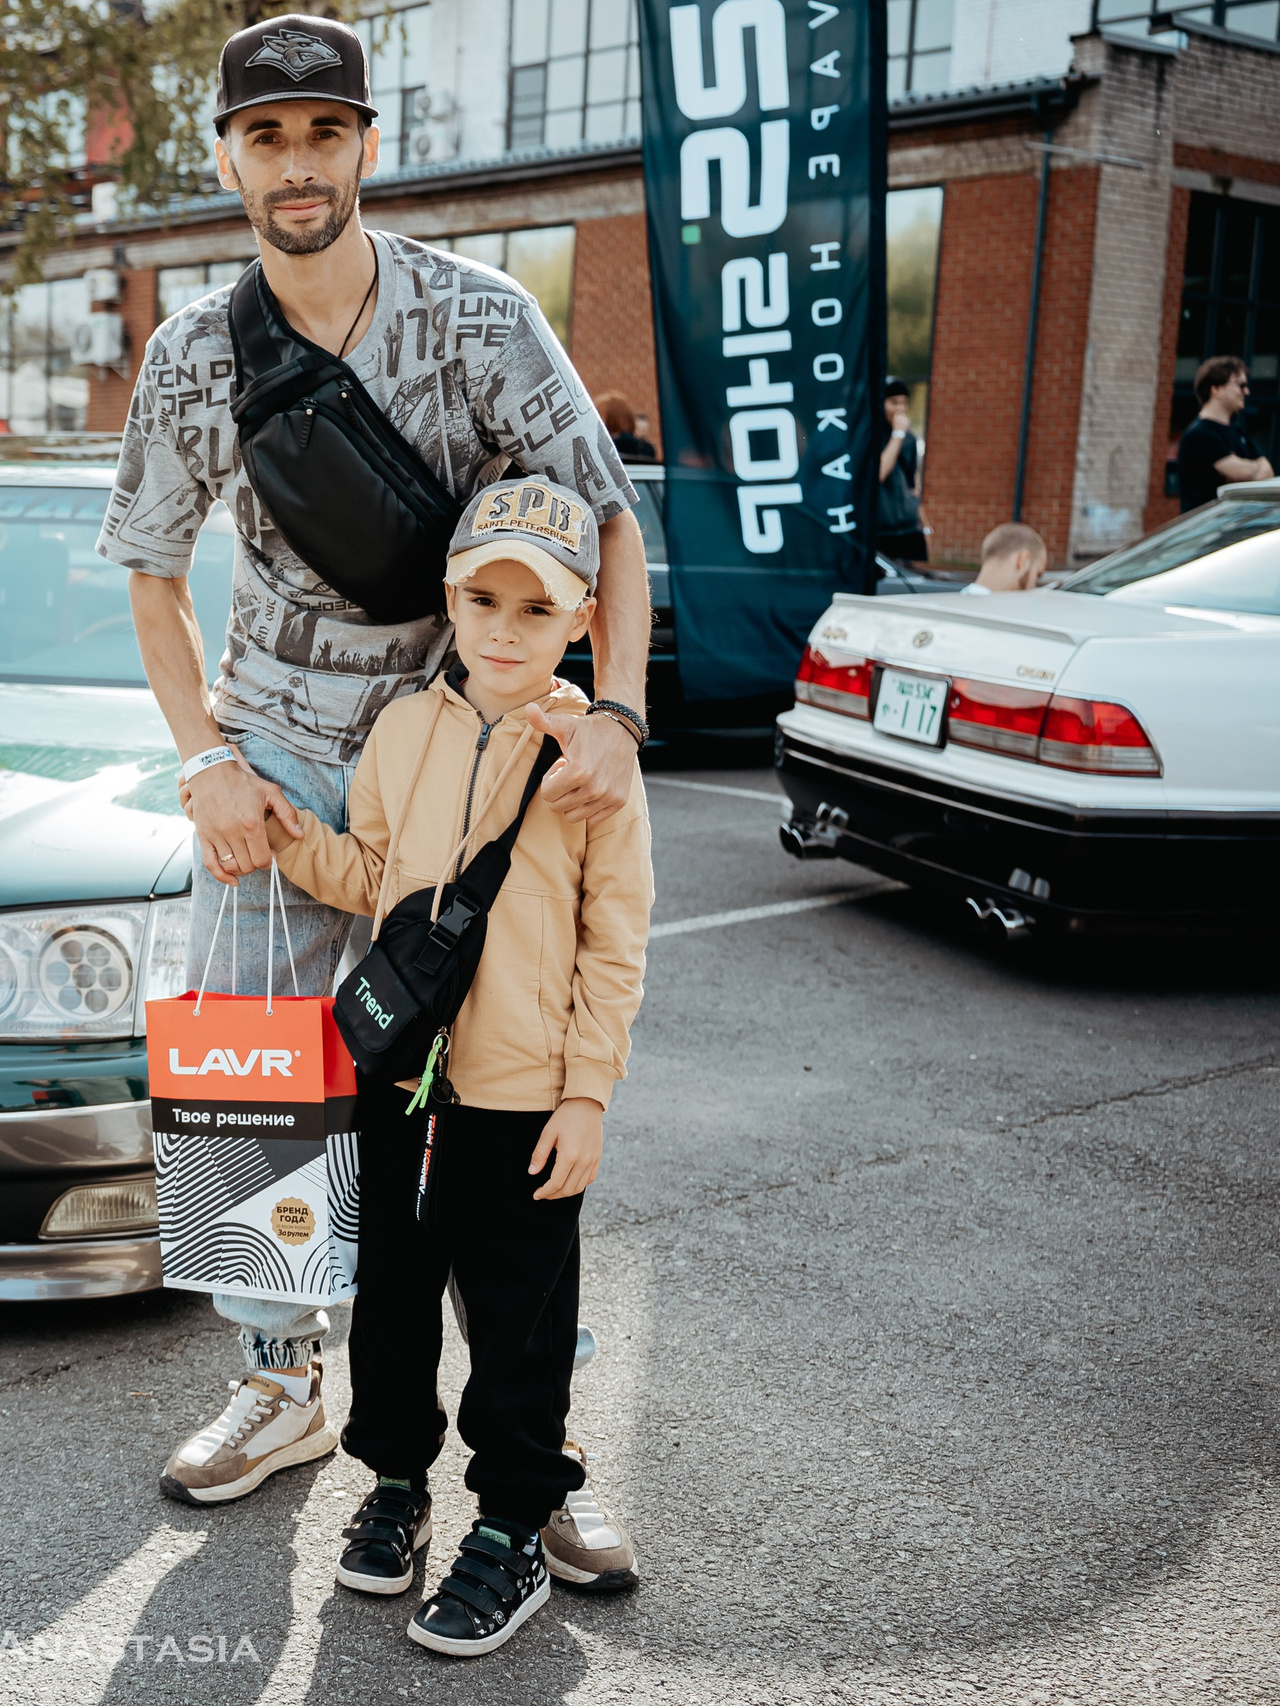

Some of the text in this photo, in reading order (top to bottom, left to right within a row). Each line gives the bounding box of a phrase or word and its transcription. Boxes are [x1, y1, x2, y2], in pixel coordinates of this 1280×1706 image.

[519, 377, 563, 424] OF
[487, 487, 571, 532] SPB
[477, 519, 576, 549] SAINT-PETERSBURG
[355, 976, 395, 1031] Trend
[172, 1107, 296, 1128] Твое решение
[425, 1113, 437, 1147] TEAM
[276, 1206, 309, 1216] БРЕНД
